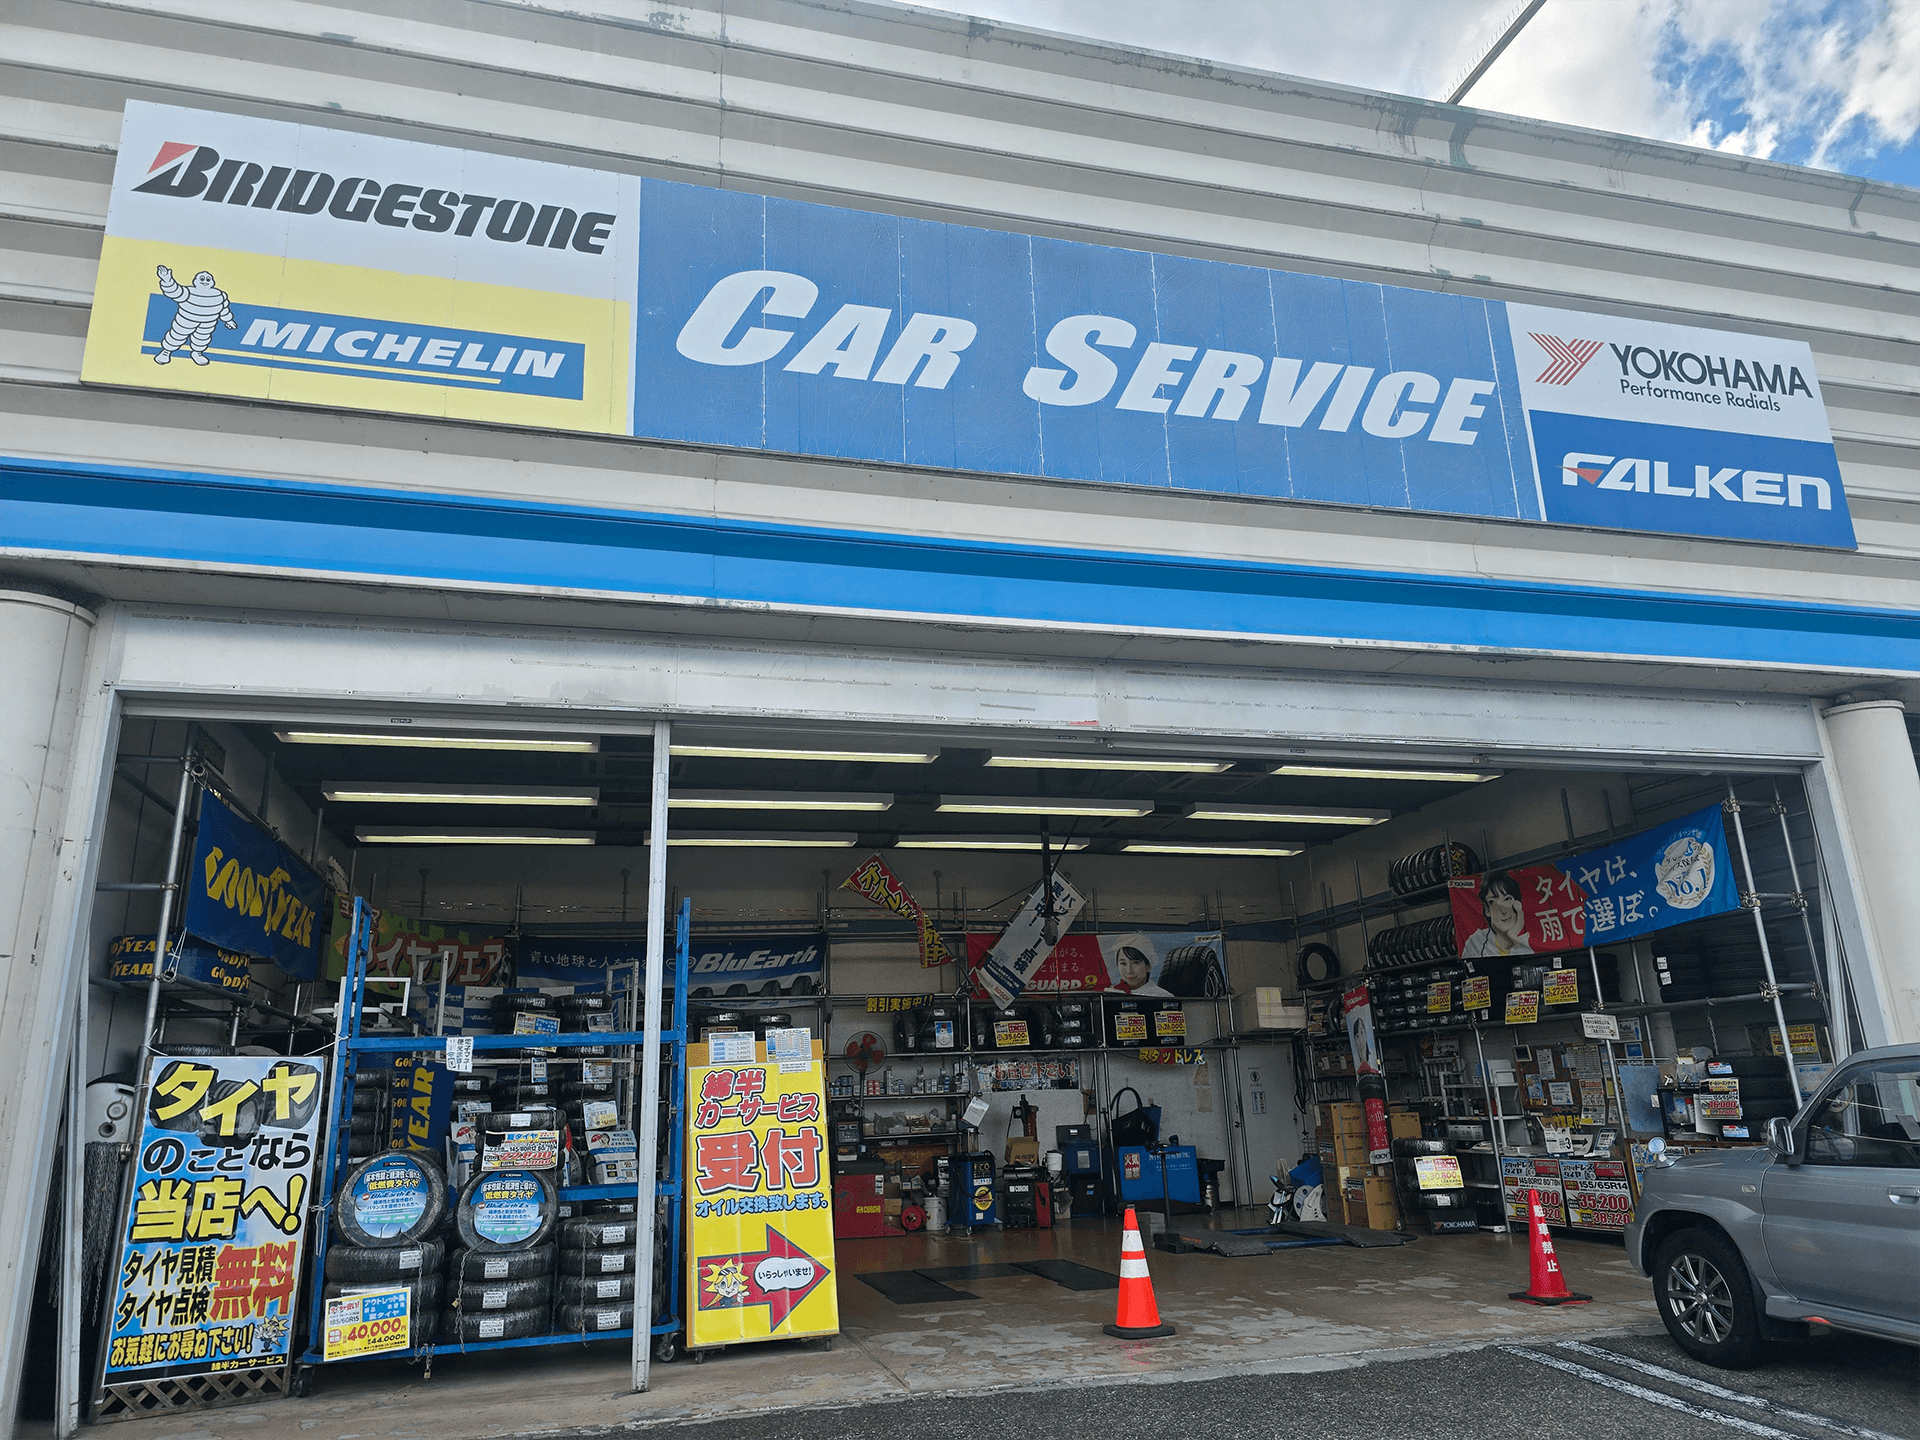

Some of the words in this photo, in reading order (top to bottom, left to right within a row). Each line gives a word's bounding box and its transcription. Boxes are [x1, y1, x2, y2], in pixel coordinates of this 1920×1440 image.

[131, 143, 617, 255] BRIDGESTONE
[241, 318, 565, 378] MICHELIN
[1609, 342, 1814, 398] YOKOHAMA
[1619, 378, 1722, 405] Performance
[1725, 391, 1781, 412] Radials
[1560, 452, 1832, 510] FALKEN
[205, 846, 316, 948] GOODYEAR
[1535, 855, 1638, 904] タイヤは、
[1665, 868, 1708, 899] No.1
[1535, 890, 1659, 944] 雨で選ぼ。
[693, 945, 818, 974] BluEarth
[155, 1063, 318, 1137] タイヤ
[701, 1069, 765, 1099] 綿半
[407, 1067, 436, 1150] YEAR
[697, 1094, 819, 1127] カーサービス
[143, 1133, 311, 1175] のことなら
[698, 1128, 820, 1191] 受付
[131, 1175, 307, 1240] 当店へ!
[696, 1191, 828, 1217] オイル交換致します。
[1578, 1194, 1629, 1211] 35,200
[1579, 1181, 1628, 1190] 155/65R14
[1443, 1221, 1477, 1229] YOKOHAMA
[1592, 1211, 1631, 1225] 38,720
[124, 1245, 216, 1288] タイヤ見積
[210, 1241, 297, 1320] 無料
[117, 1286, 211, 1330] タイヤ点検
